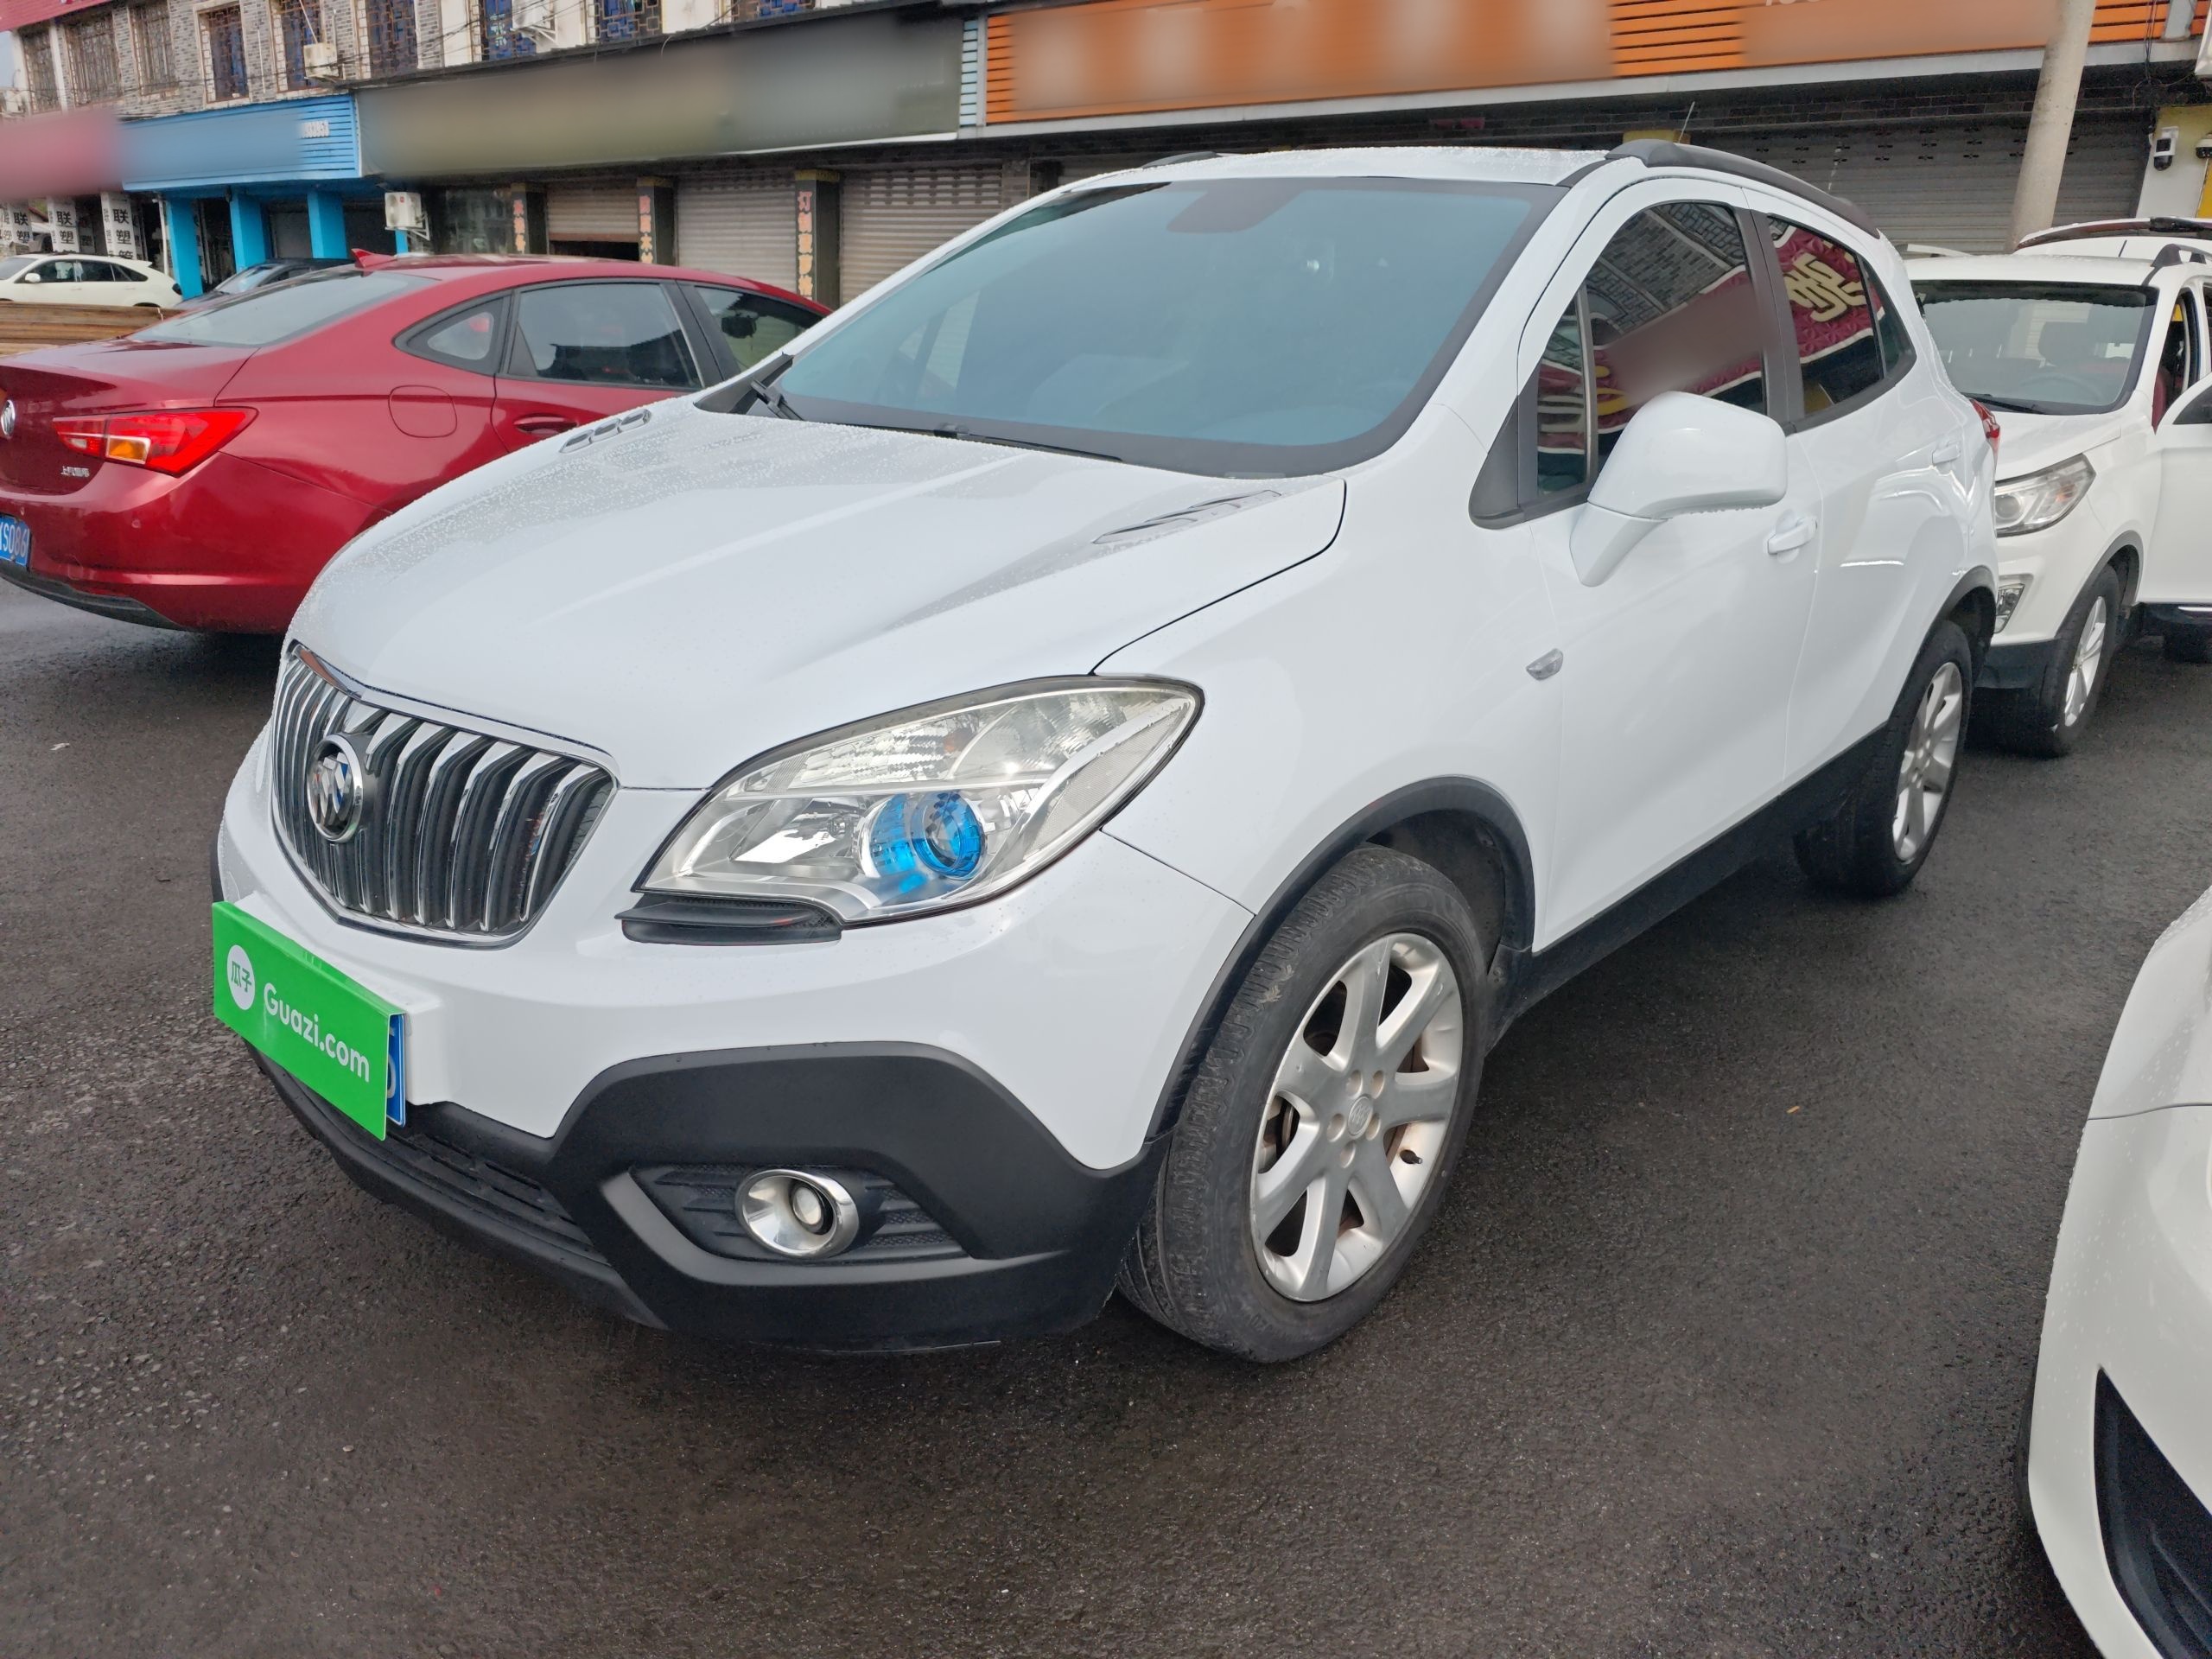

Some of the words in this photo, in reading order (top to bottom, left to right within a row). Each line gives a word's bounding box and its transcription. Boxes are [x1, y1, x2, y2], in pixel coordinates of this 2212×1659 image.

[56, 211, 76, 252] 联塑
[231, 960, 252, 993] 瓜子
[264, 982, 370, 1083] Guazi.com
